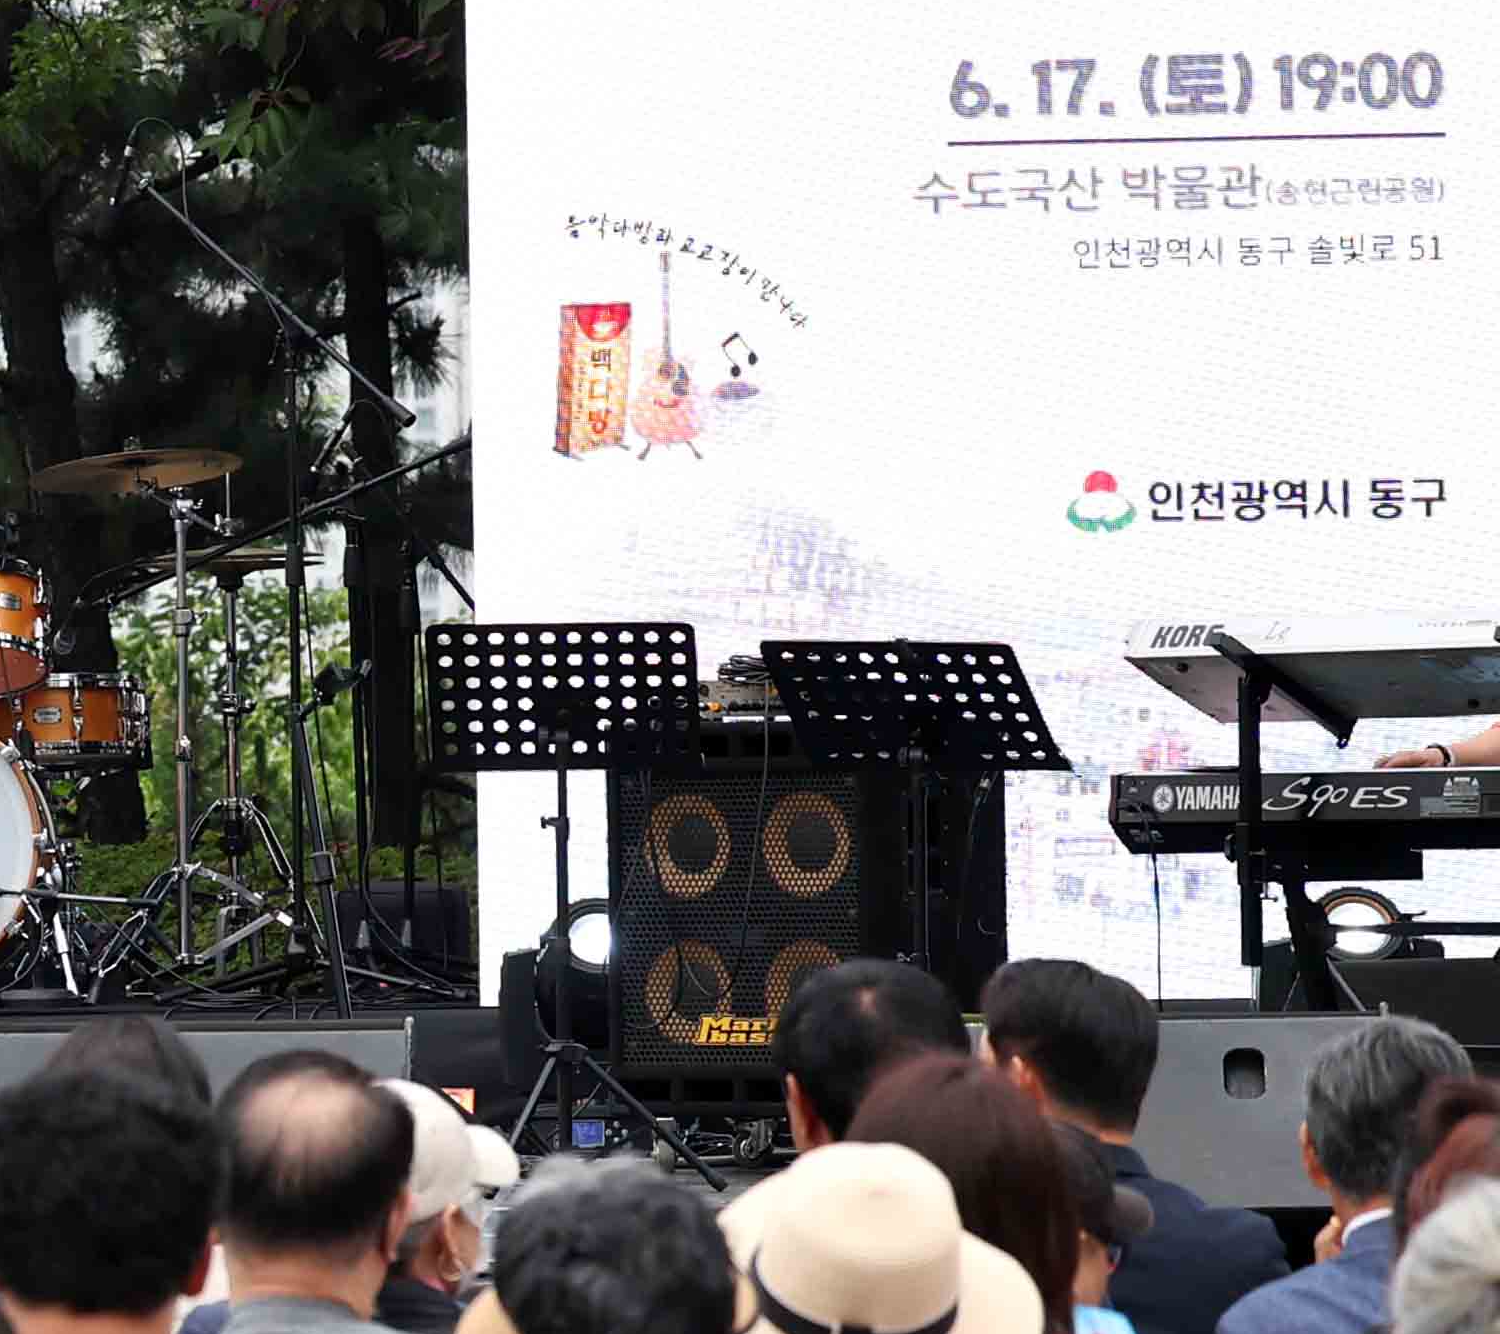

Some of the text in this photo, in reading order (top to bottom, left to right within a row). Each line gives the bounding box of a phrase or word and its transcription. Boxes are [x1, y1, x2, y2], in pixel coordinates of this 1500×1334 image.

[948, 50, 1445, 121] 6. 17. (토) 19:00
[912, 166, 1104, 215] 수도국산
[1073, 234, 1444, 269] 인천광역시 동구 솔빛로 51
[1149, 478, 1448, 522] 인천광역시 동구
